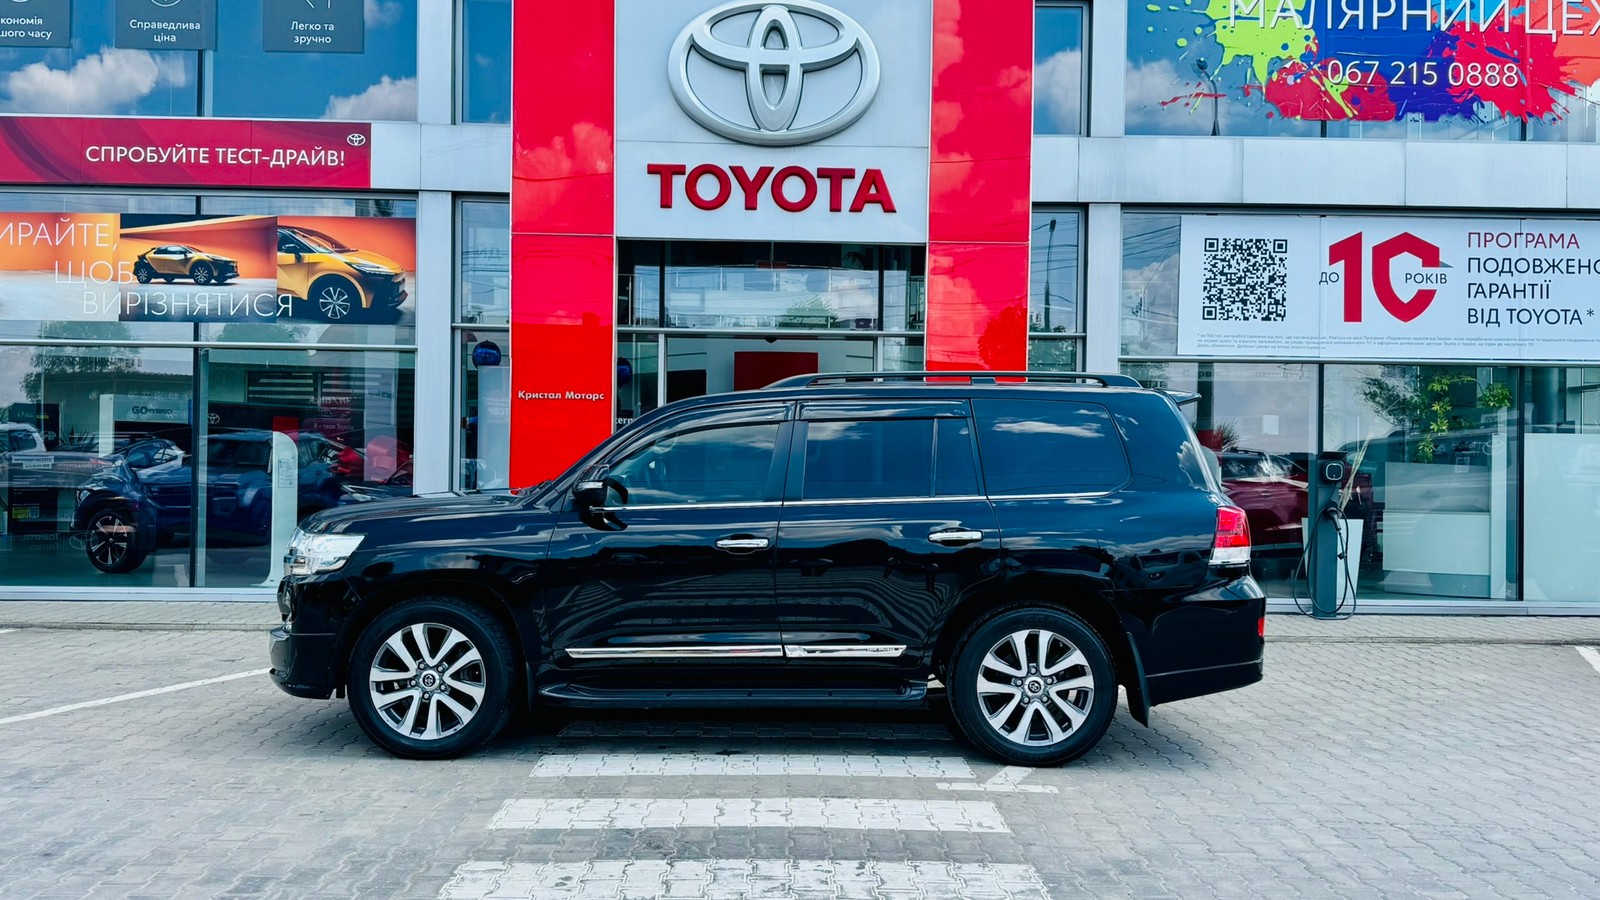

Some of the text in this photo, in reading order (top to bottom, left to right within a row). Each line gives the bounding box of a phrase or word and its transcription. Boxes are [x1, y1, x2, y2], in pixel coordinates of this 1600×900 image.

[129, 19, 201, 30] Справедлива
[290, 21, 335, 31] Легко та
[28, 30, 52, 40] часу
[153, 33, 177, 43] ціна
[293, 35, 332, 44] зручно
[1327, 59, 1519, 88] 067 215 0888
[85, 143, 345, 168] СПРОБУЙТЕ ТЕСТ-ДРАЙВ!
[647, 163, 897, 213] TOYOTA
[1468, 232, 1581, 249] ПРОГРАМА
[54, 260, 133, 289] ЩОБ
[1318, 271, 1340, 286] ДО
[1404, 272, 1448, 285] РОКІВ
[1467, 279, 1552, 299] ГАРАНТІЇ
[82, 290, 294, 318] ВИРІЗНЯТИСЯ
[1467, 307, 1583, 328] ВІД TOYOTA
[518, 390, 605, 402] Кристал Моторс
